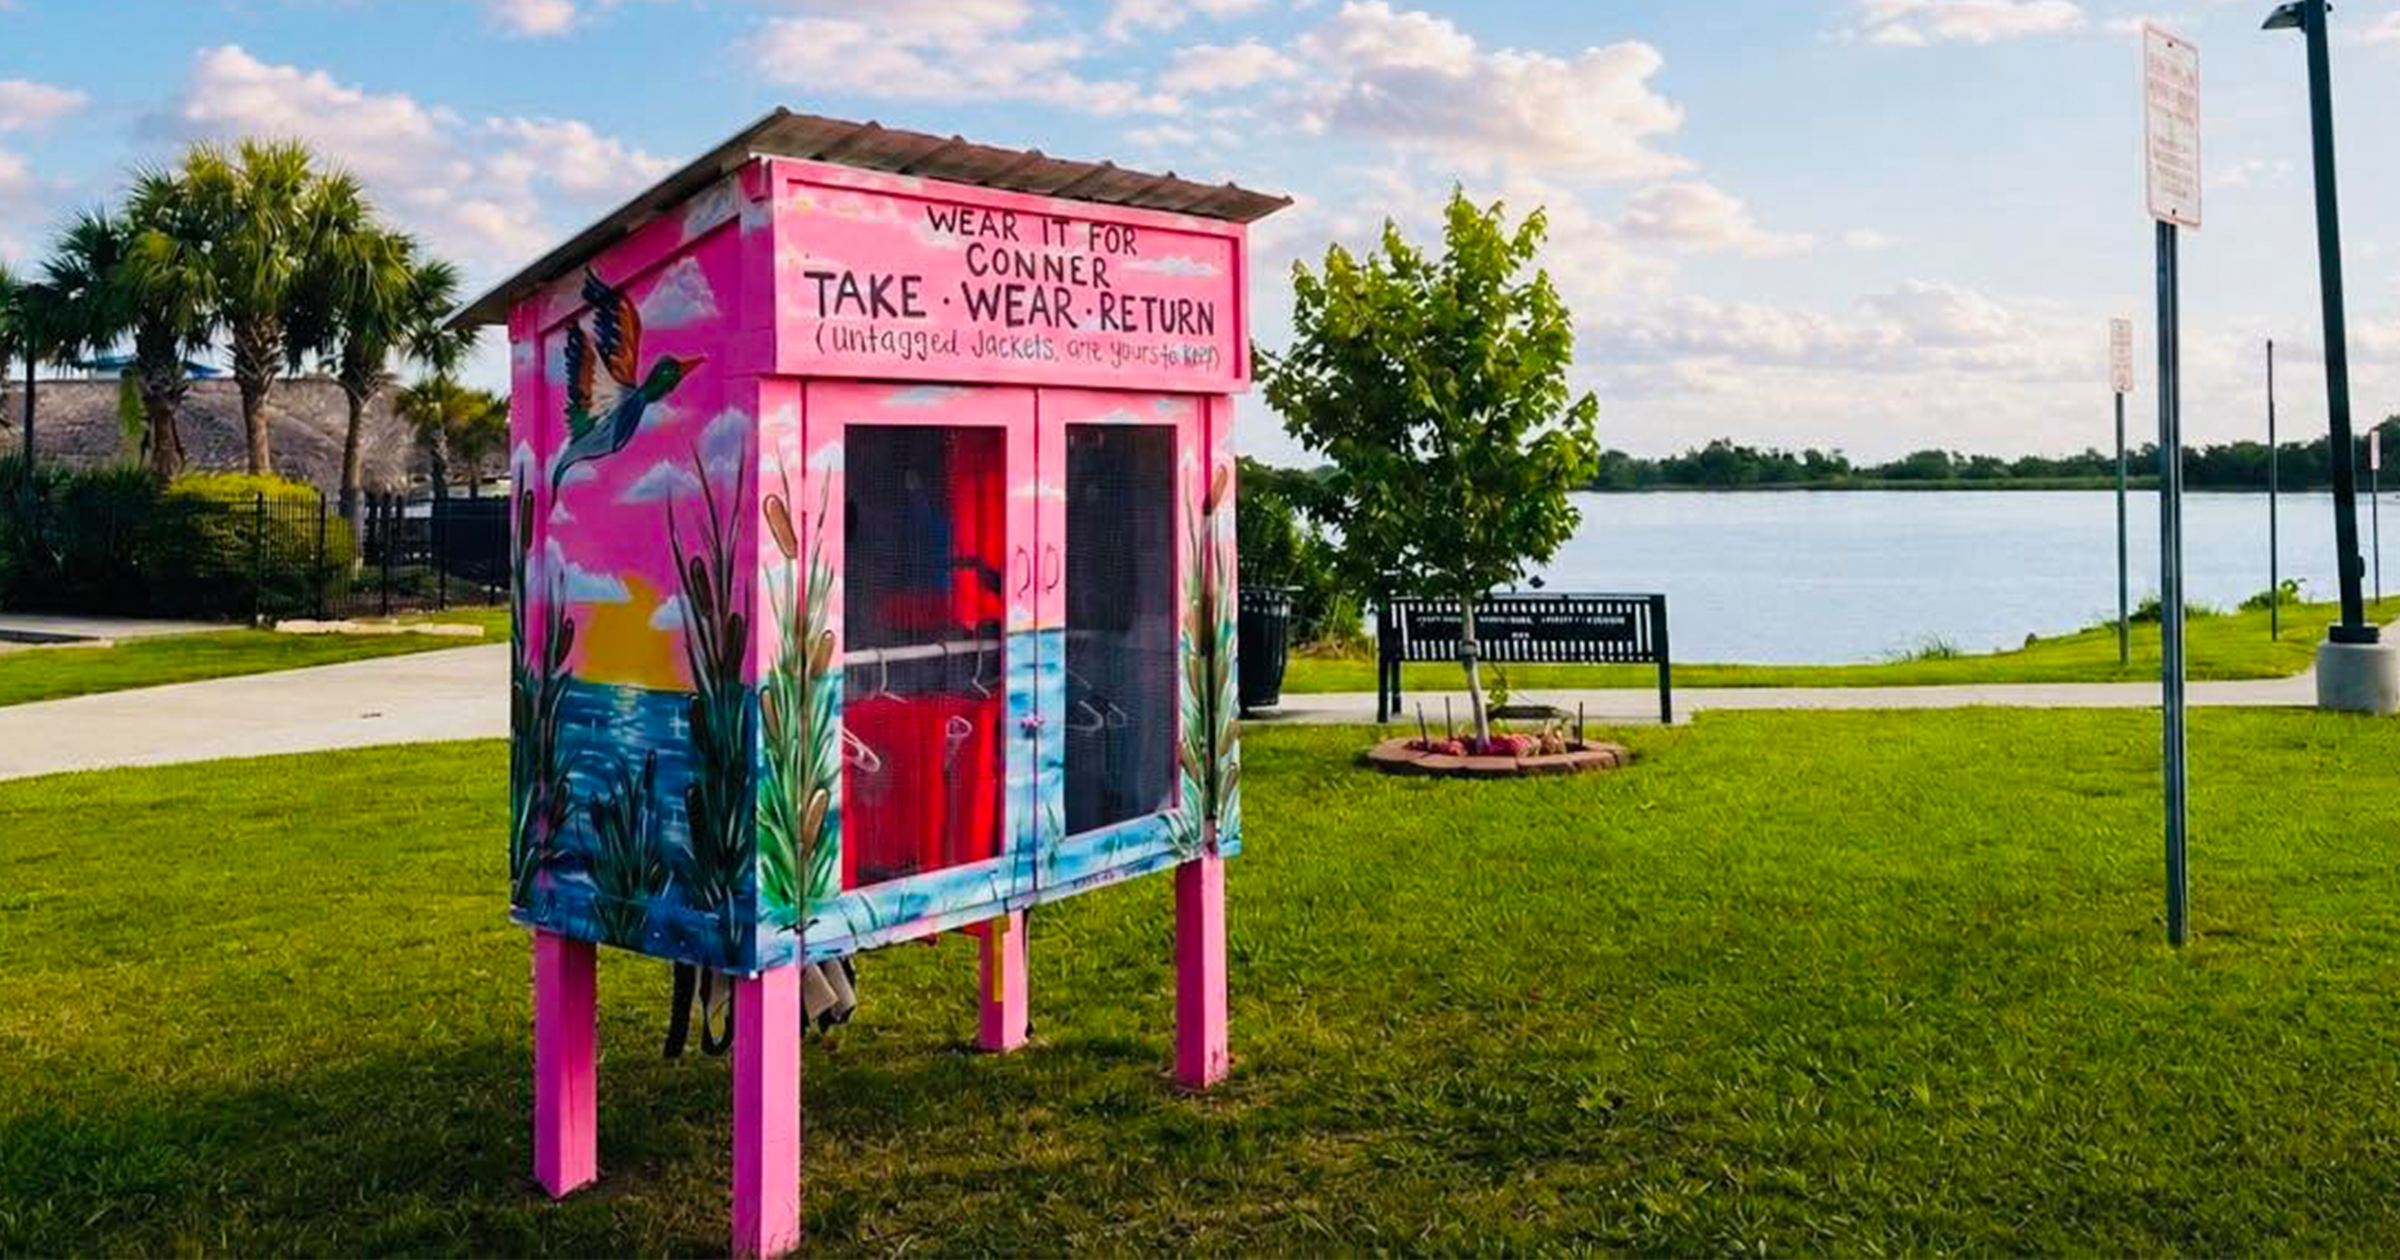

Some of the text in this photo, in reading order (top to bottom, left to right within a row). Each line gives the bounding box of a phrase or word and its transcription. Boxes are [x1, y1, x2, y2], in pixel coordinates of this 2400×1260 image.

[926, 204, 1138, 256] WEAR IT FOR
[966, 242, 1111, 288] CONNER
[803, 270, 1214, 336] TAKE WEAR RETURN
